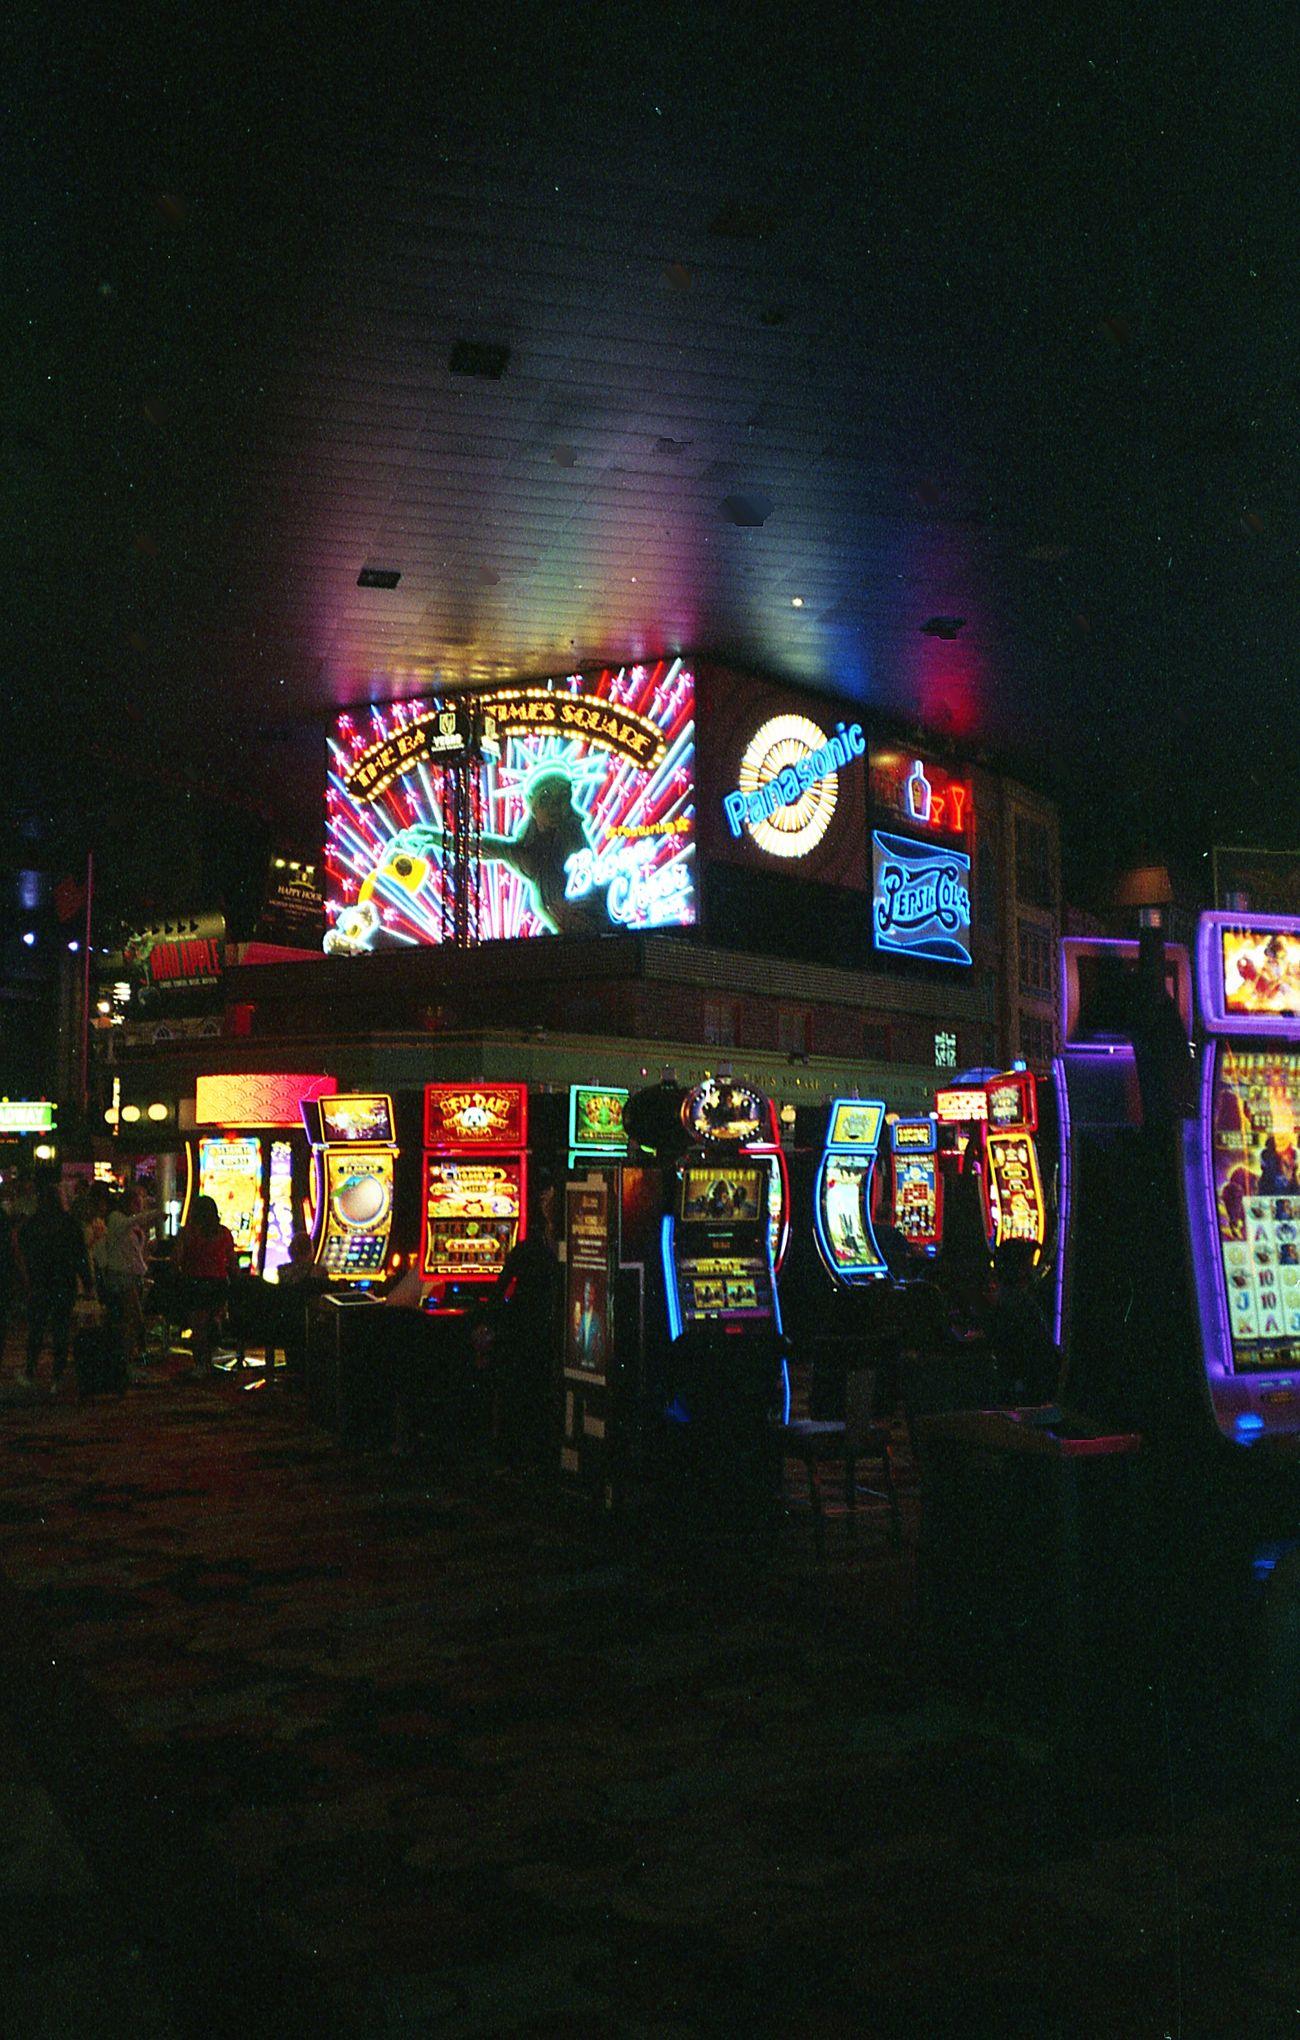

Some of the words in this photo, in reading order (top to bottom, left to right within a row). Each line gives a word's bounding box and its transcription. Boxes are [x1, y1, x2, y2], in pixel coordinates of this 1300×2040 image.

[397, 729, 426, 756] BA
[482, 702, 556, 721] TIMES
[559, 704, 652, 756] SQUARE
[724, 722, 866, 838] Panasonic
